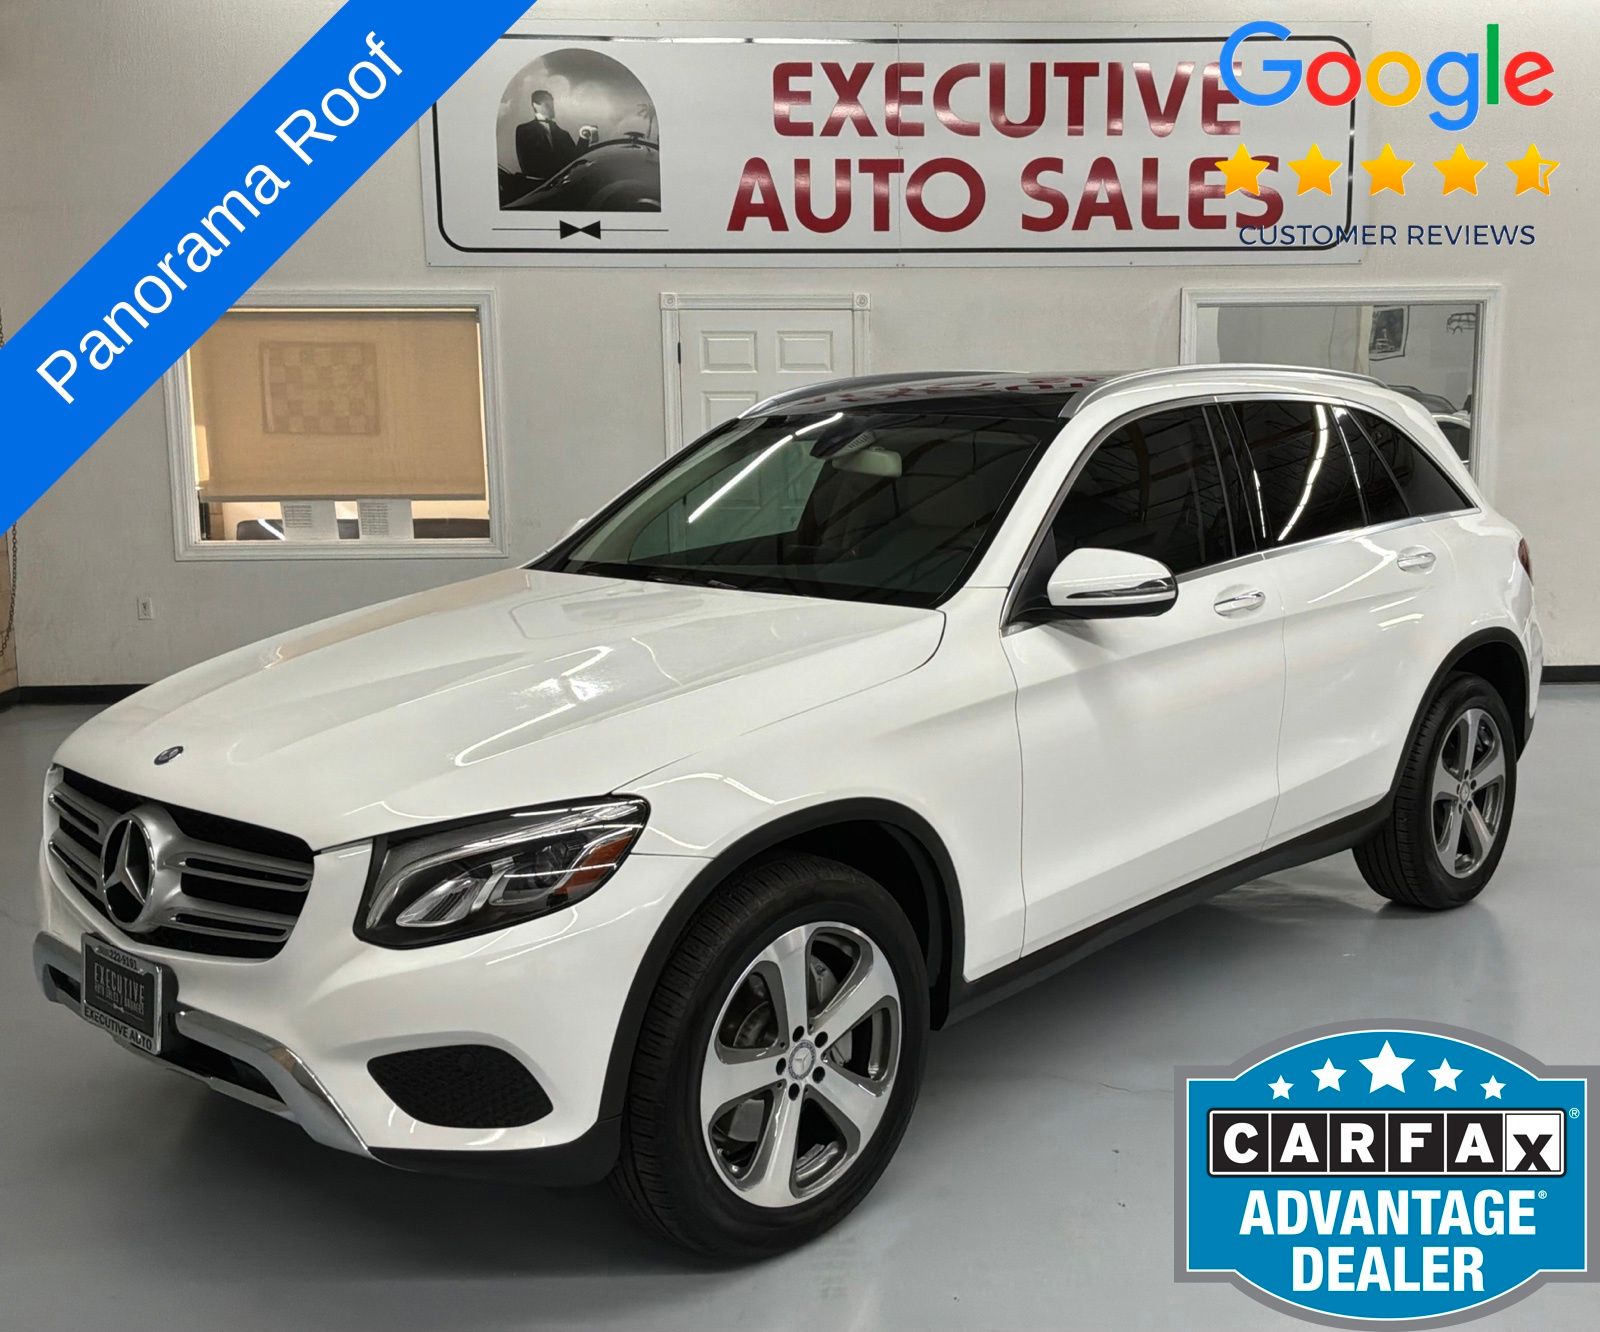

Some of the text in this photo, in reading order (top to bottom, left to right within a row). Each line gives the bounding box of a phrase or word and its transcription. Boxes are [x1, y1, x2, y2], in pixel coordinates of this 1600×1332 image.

[773, 61, 1243, 138] EXECUTIVE
[726, 155, 1284, 233] AUTO SALES
[94, 962, 145, 1003] EXECUTIVE
[85, 1006, 153, 1051] EXECUTIVE AUTO
